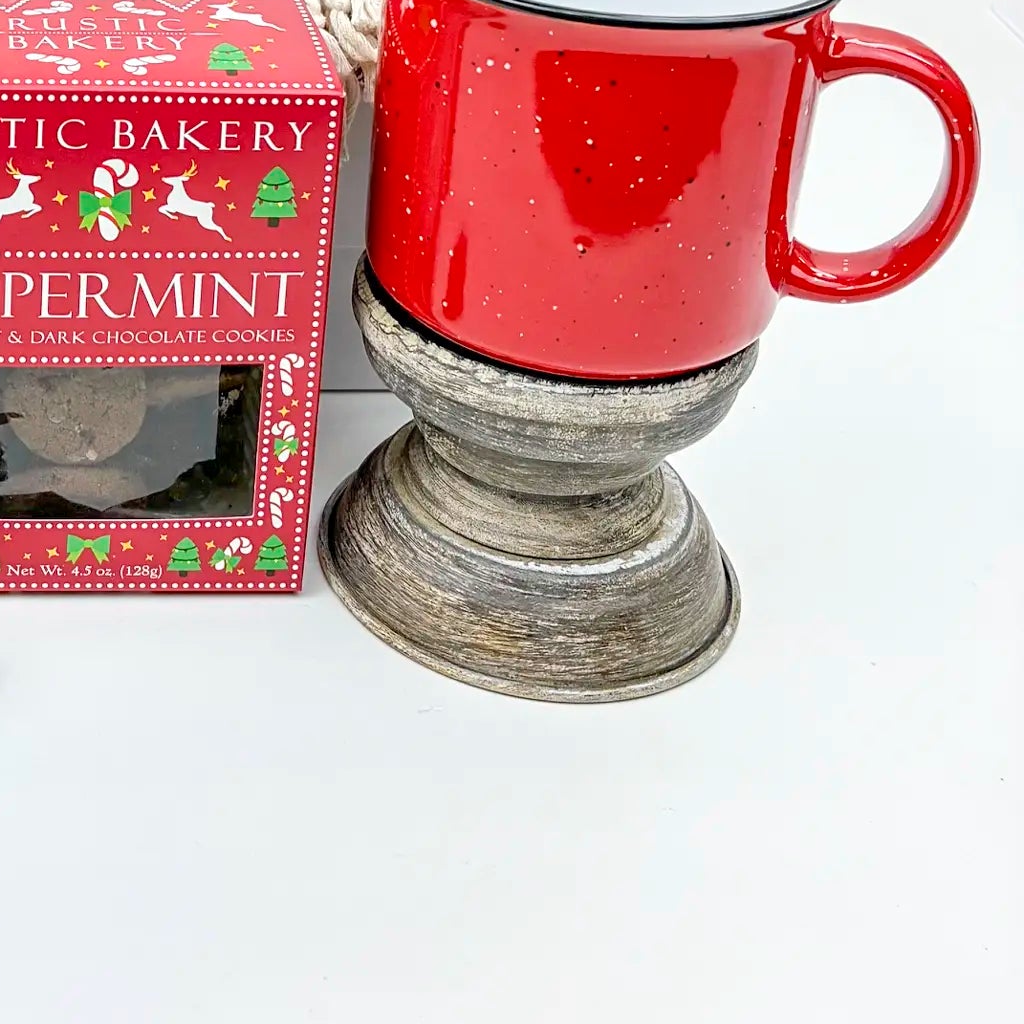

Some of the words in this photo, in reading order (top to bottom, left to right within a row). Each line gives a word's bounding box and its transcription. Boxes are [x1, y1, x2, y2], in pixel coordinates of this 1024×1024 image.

[7, 17, 187, 33] RUSTIC
[7, 34, 189, 52] BAKERY
[111, 119, 313, 152] BAKERY
[7, 330, 23, 344] &
[30, 330, 85, 345] DARK
[91, 330, 207, 344] CHOCOLATE
[212, 328, 295, 343] COOKIES
[6, 564, 35, 577] Net
[39, 564, 67, 577] Wt.
[71, 565, 93, 577] 4.5
[95, 567, 116, 577] oz.
[119, 564, 163, 579] (128g)
